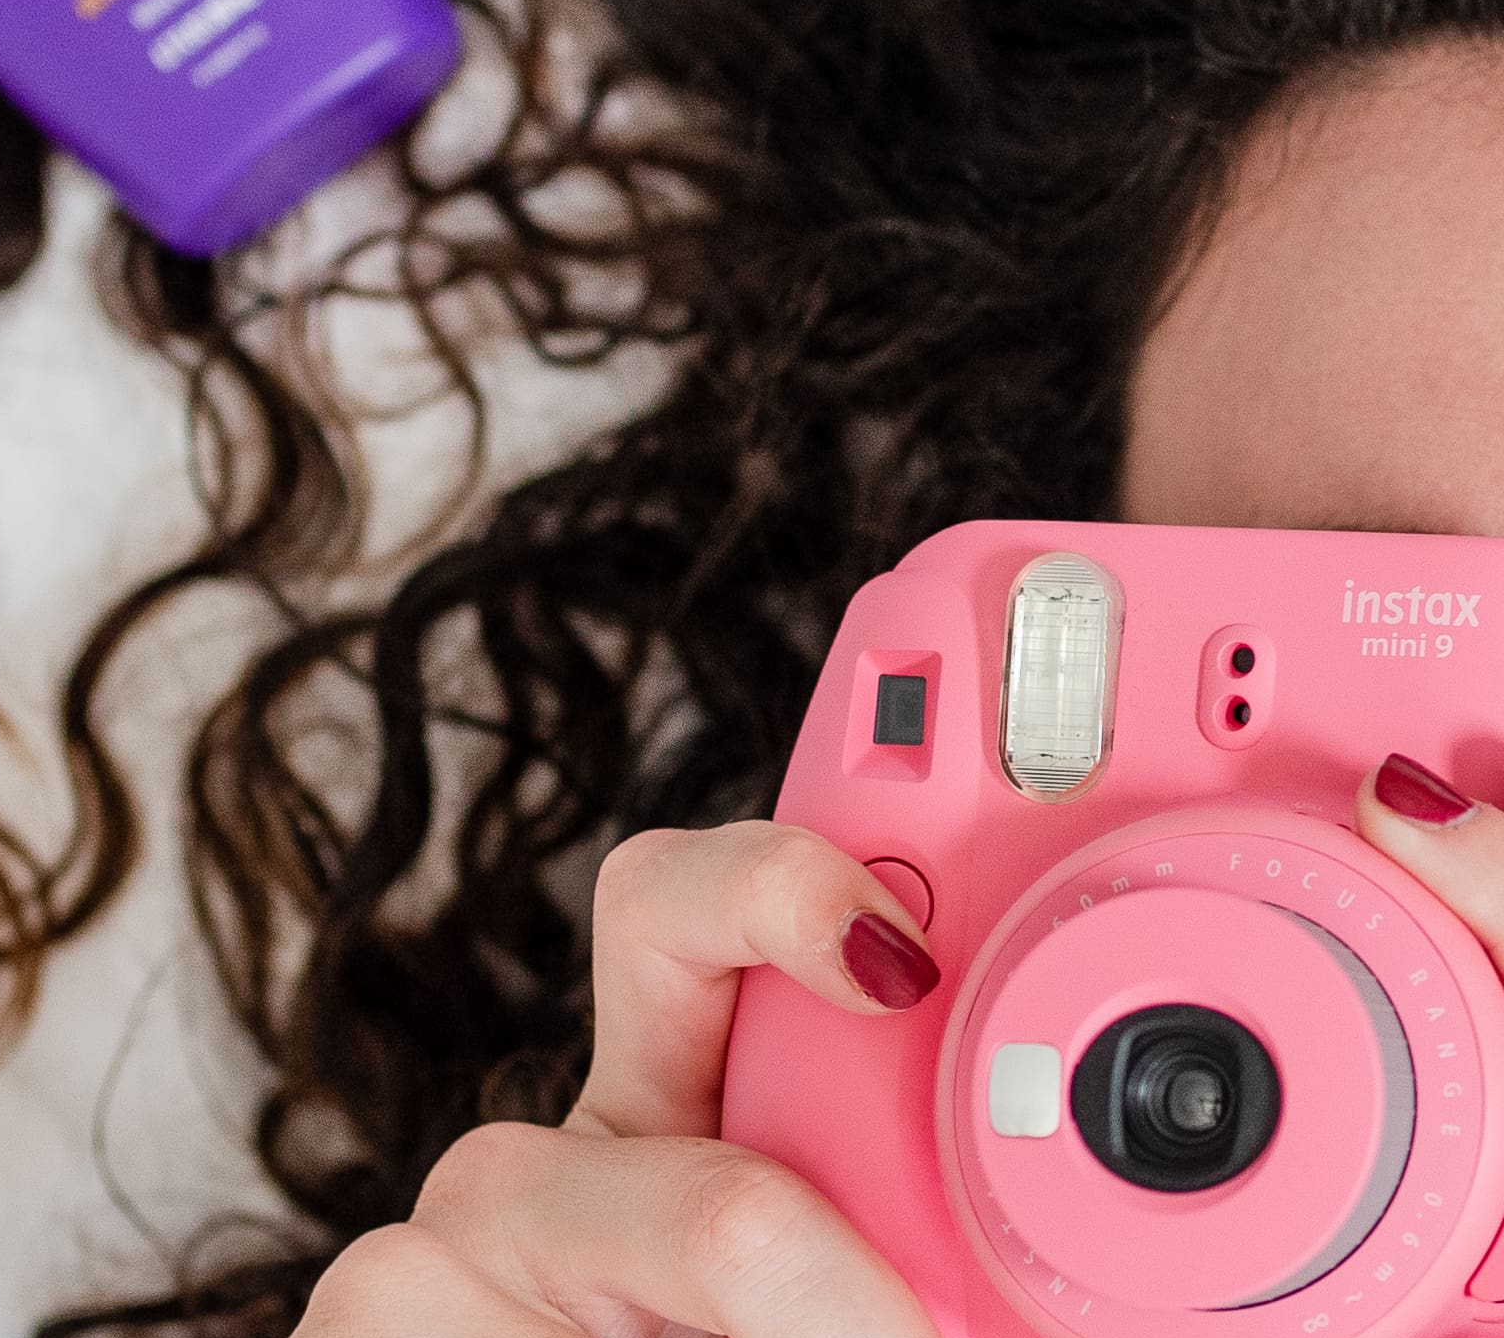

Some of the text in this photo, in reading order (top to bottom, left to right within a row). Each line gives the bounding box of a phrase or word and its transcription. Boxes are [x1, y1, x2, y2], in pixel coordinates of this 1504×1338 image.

[1341, 579, 1482, 628] instax
[1361, 632, 1454, 659] mini 9
[1228, 852, 1384, 931] FOCUS
[1407, 967, 1463, 1137] RANGE
